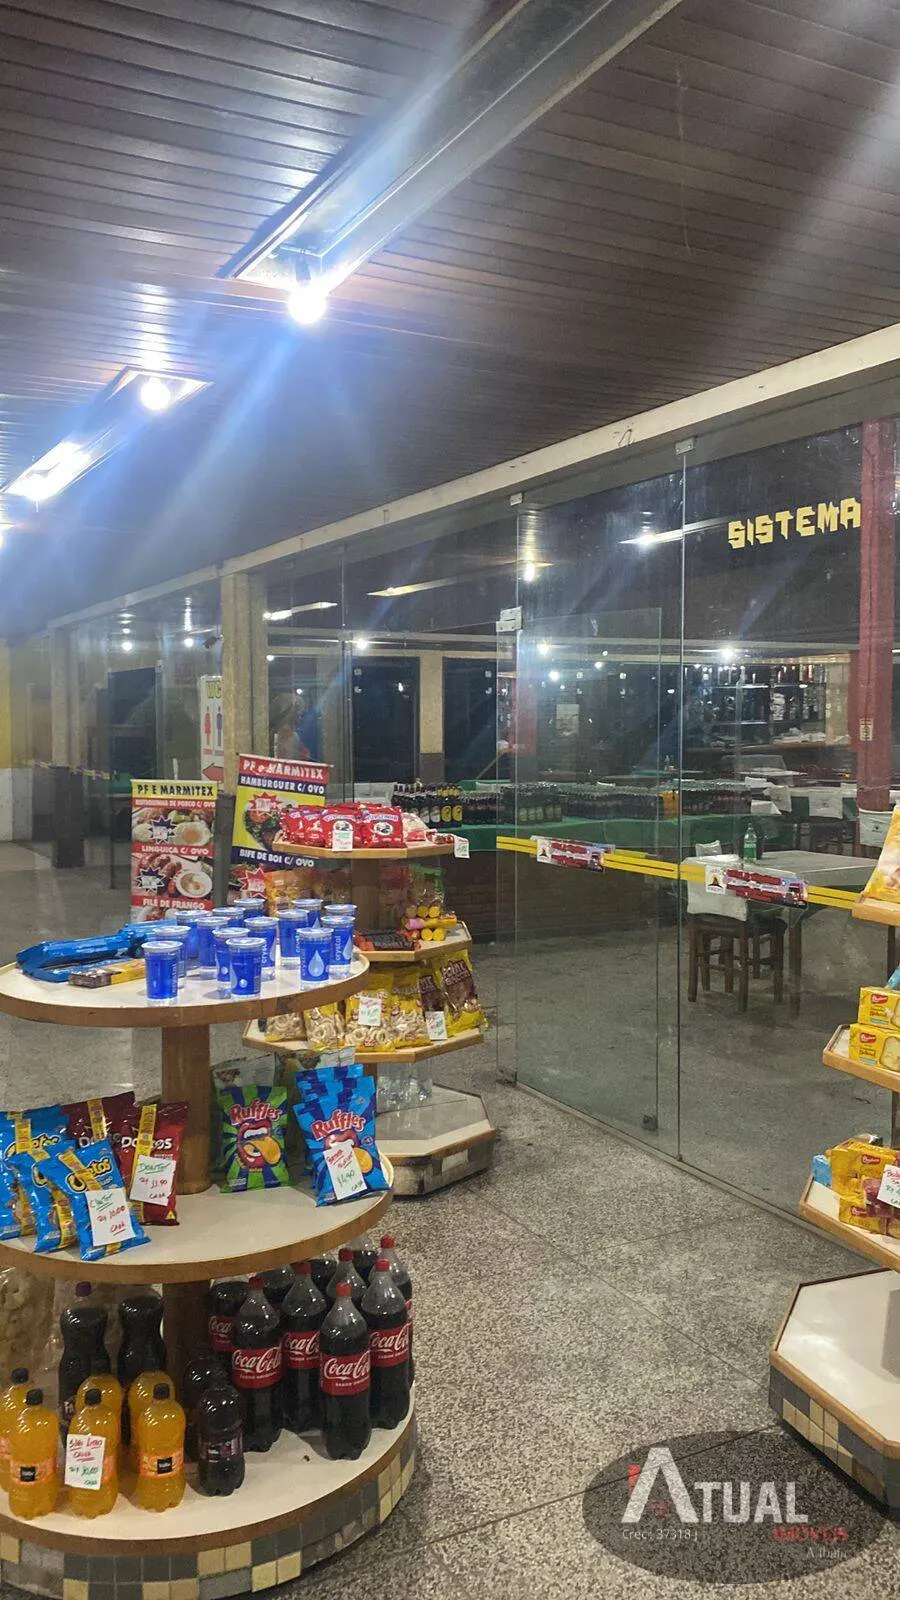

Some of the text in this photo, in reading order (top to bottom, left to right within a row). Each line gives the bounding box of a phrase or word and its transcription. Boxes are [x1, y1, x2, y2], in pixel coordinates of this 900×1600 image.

[728, 498, 861, 549] SISTEMA
[243, 759, 256, 770] PF
[266, 763, 323, 779] MARMITEX
[137, 785, 149, 794] PF
[160, 786, 214, 796] MARMITEX
[297, 783, 306, 792] C/
[308, 785, 325, 794] OVO
[240, 849, 314, 867] BIFE DE BOI C/ OVO
[171, 900, 205, 909] FRANGO
[230, 1101, 282, 1126] Ruffles
[311, 1109, 366, 1140] Ruffles
